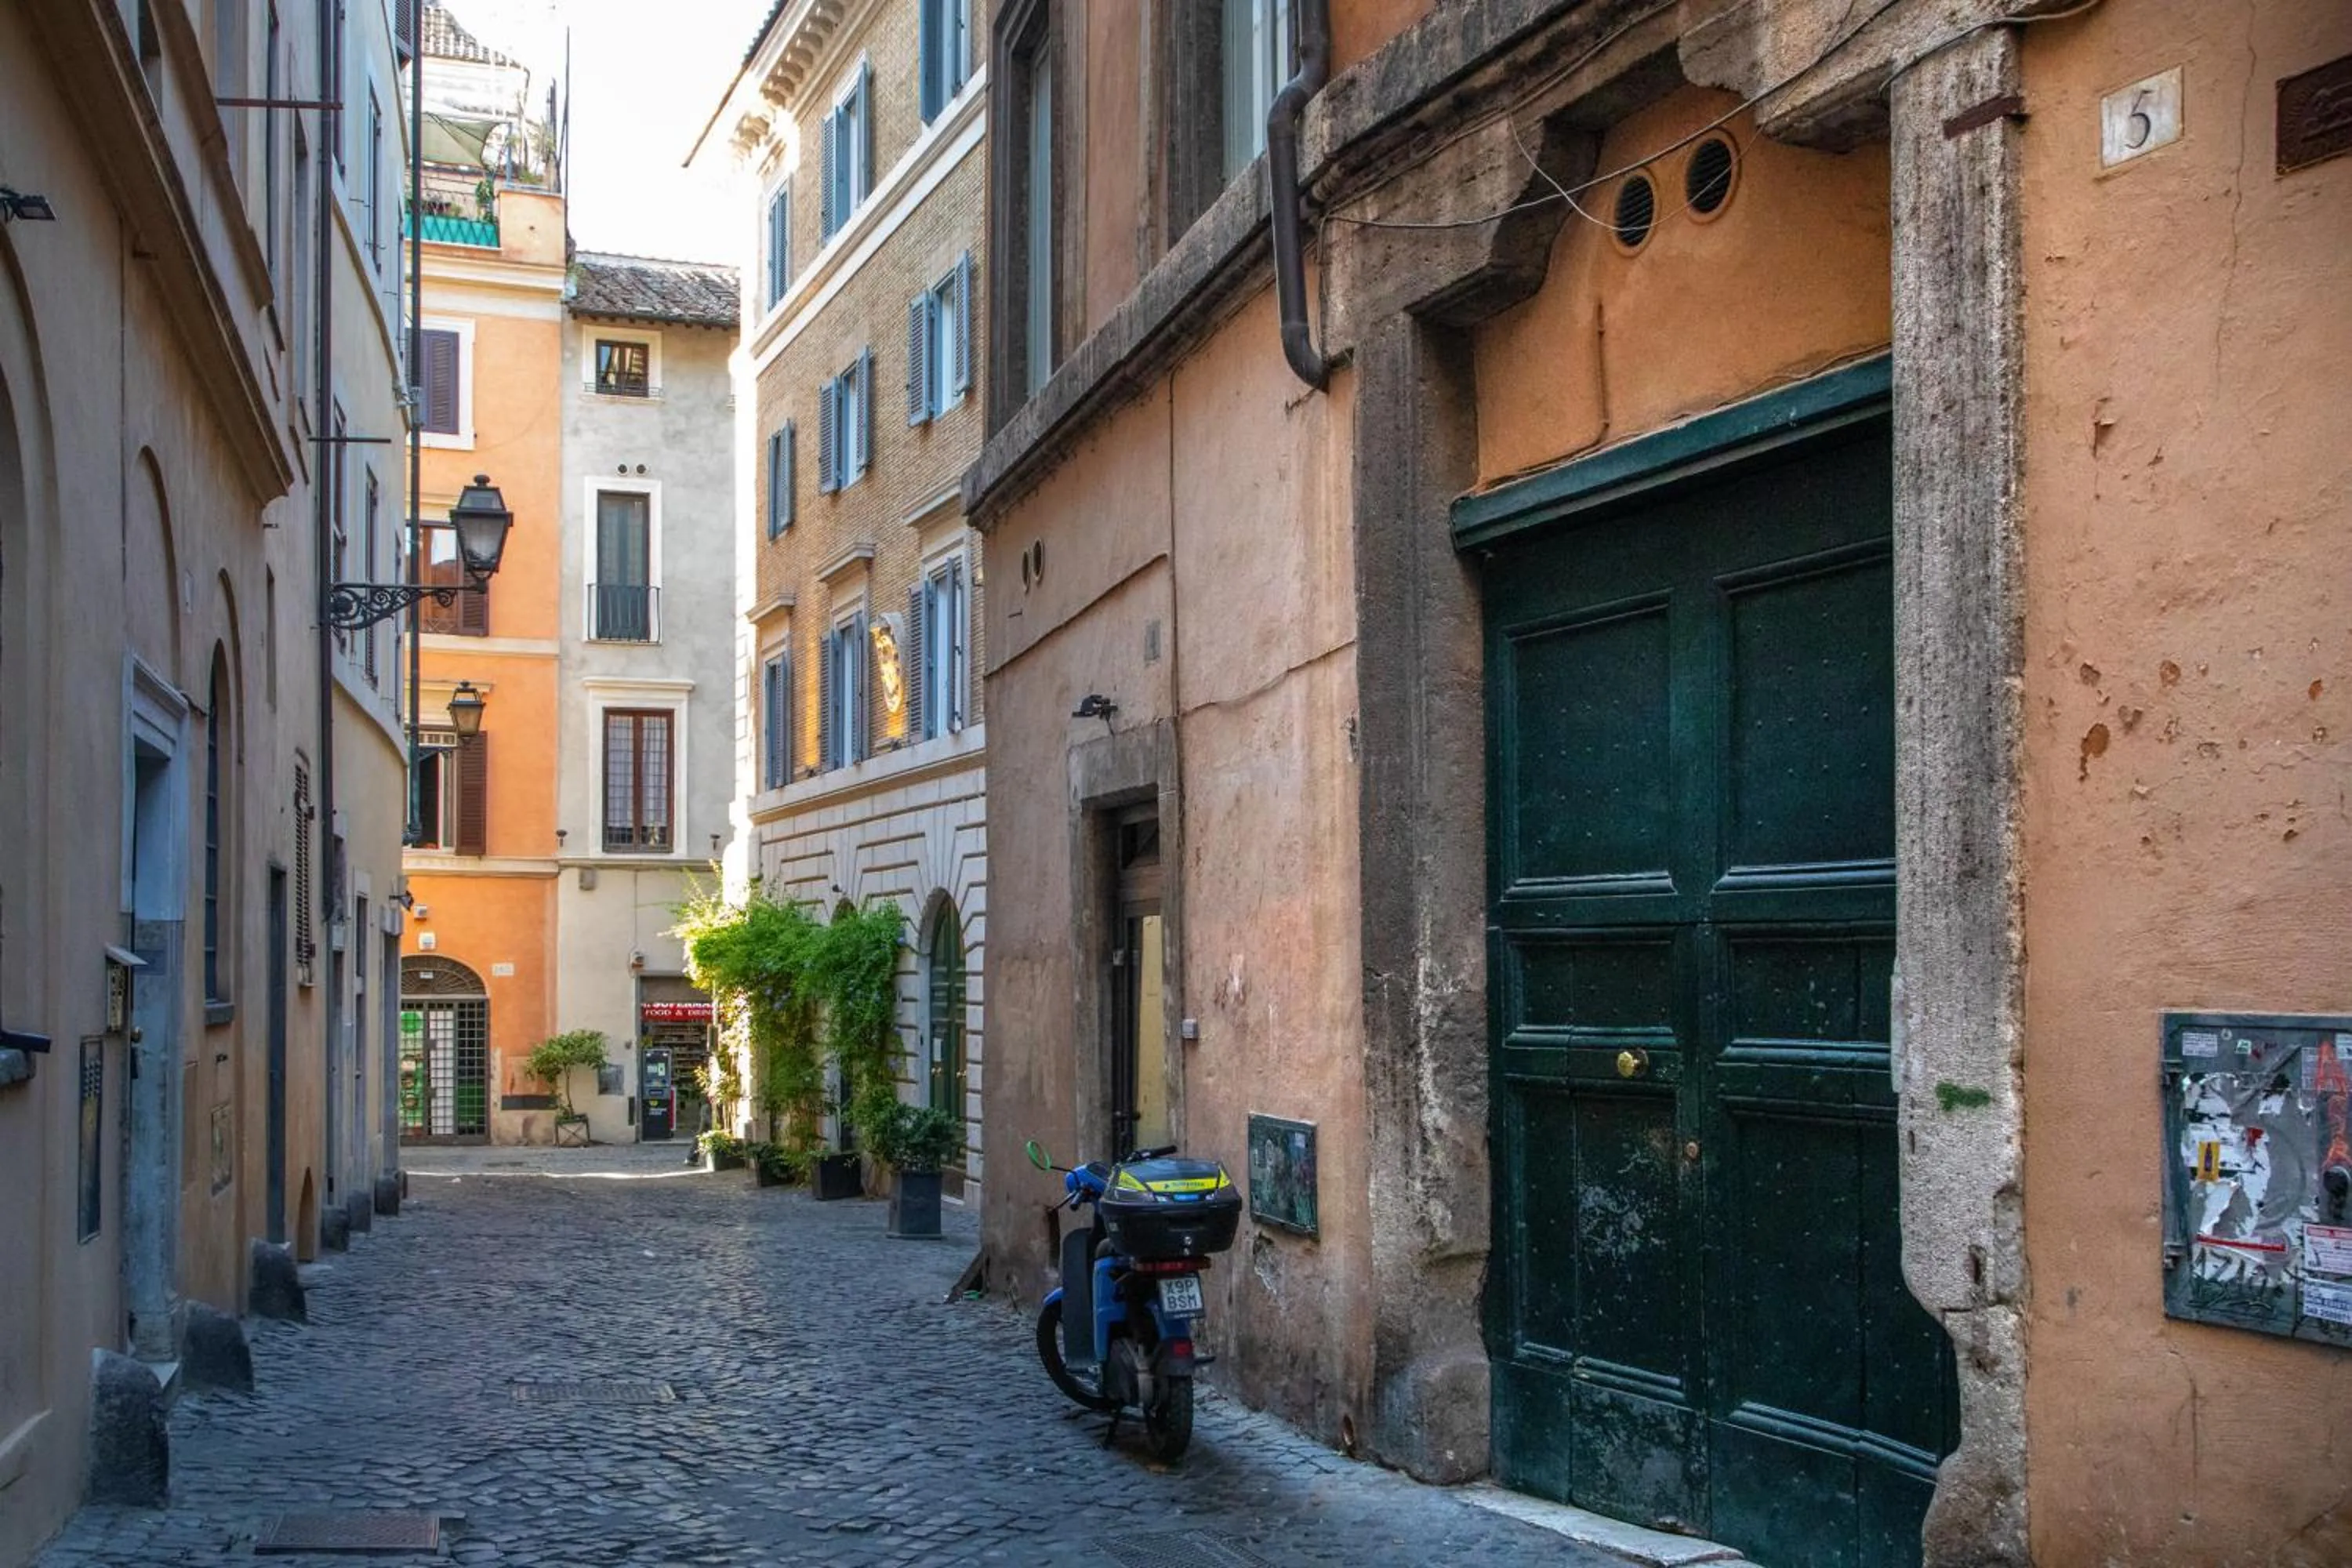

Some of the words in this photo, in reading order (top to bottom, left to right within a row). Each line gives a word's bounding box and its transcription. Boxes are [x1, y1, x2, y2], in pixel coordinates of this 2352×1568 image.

[2124, 89, 2154, 149] 5
[1167, 1279, 1193, 1294] X9P
[1167, 1294, 1198, 1309] BSM
